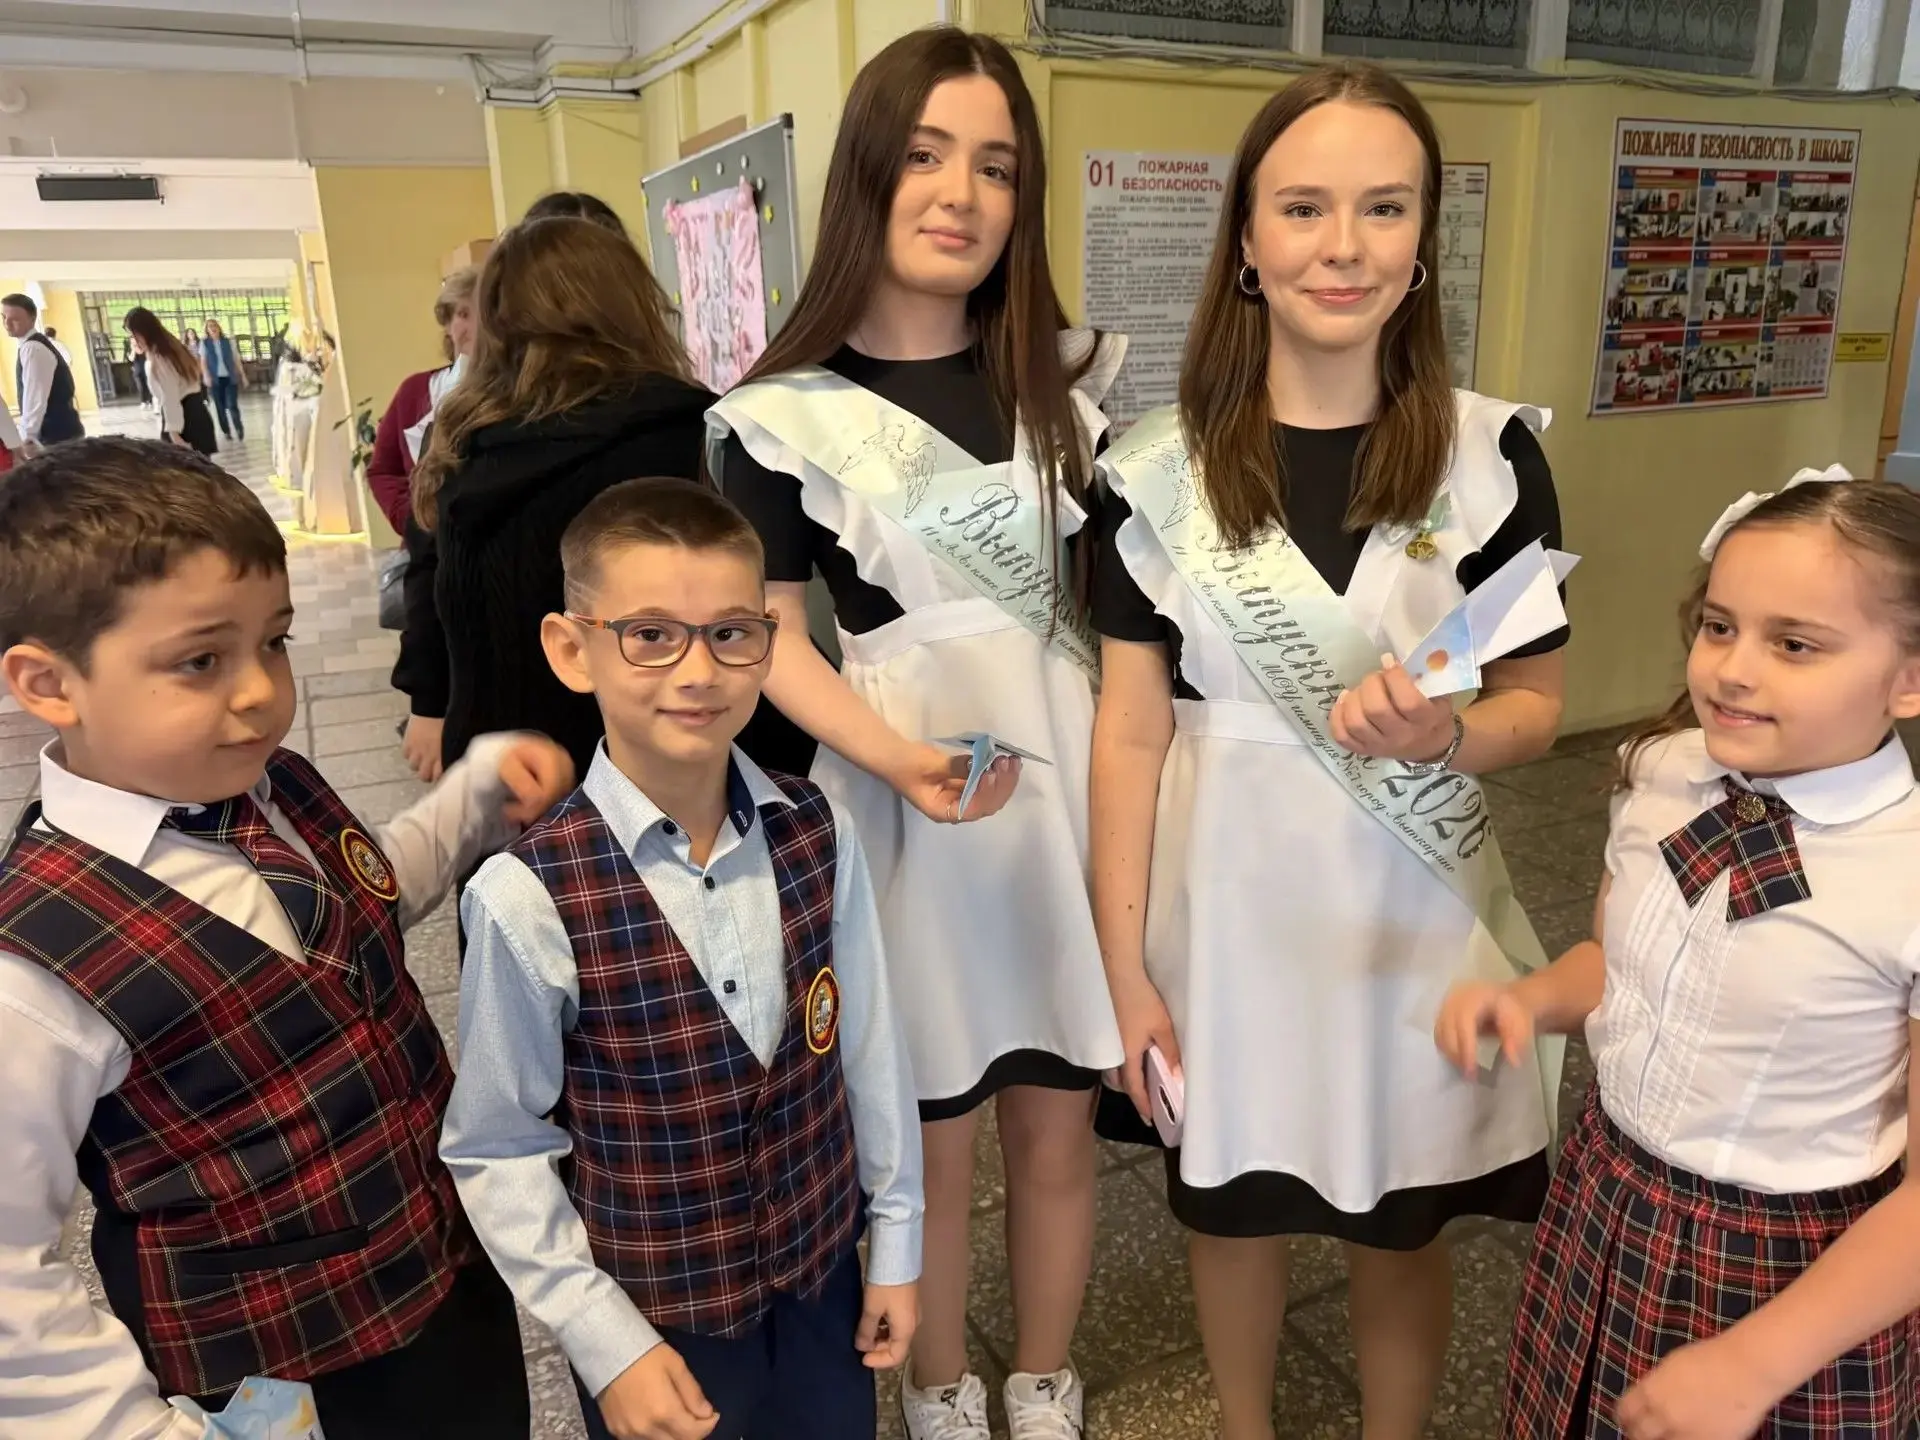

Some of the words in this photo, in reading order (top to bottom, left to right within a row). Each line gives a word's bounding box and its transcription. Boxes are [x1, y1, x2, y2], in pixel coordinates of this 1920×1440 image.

[1622, 130, 1696, 157] ПОЖАРНАЯ
[1700, 133, 1793, 161] БЕЗОПАСНОСТЬ
[1797, 138, 1806, 161] В
[1809, 138, 1854, 163] ШКОЛЕ
[1089, 160, 1115, 187] 01
[1138, 160, 1209, 174] ПОЖАРНАЯ
[1122, 177, 1223, 192] БЕЗОПАСНОСТЬ
[1256, 659, 1303, 702] МОУ
